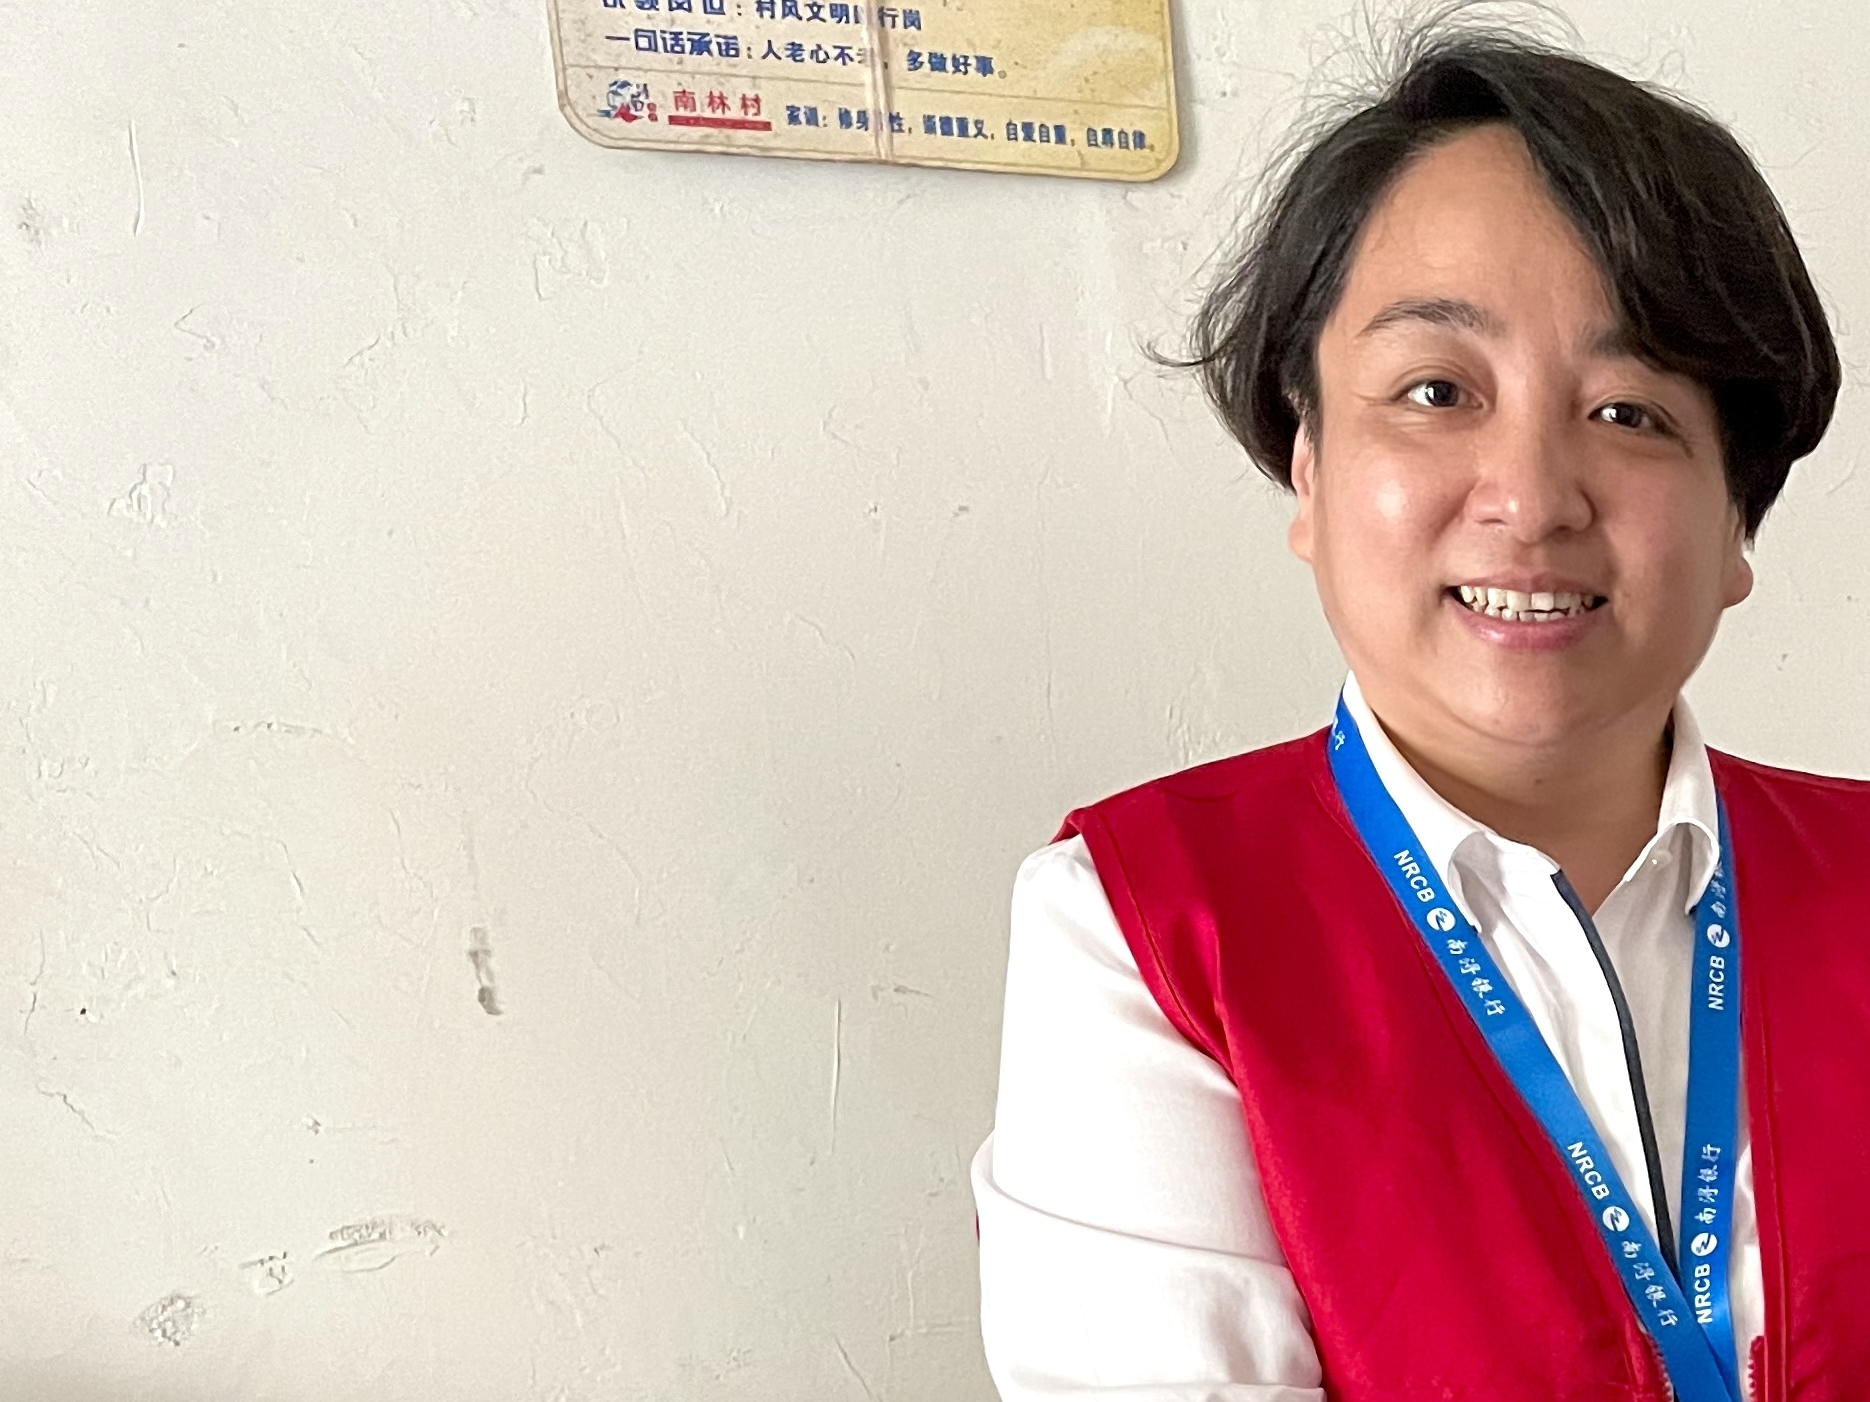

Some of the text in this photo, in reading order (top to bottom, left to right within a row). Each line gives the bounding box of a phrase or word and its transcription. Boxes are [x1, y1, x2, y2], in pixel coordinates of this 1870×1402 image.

[673, 89, 762, 117] 南林村
[1393, 849, 1435, 903] NRCB
[1708, 955, 1725, 1011] NRCB
[1567, 1141, 1610, 1200] NRCB
[1694, 1263, 1713, 1324] NRCB
